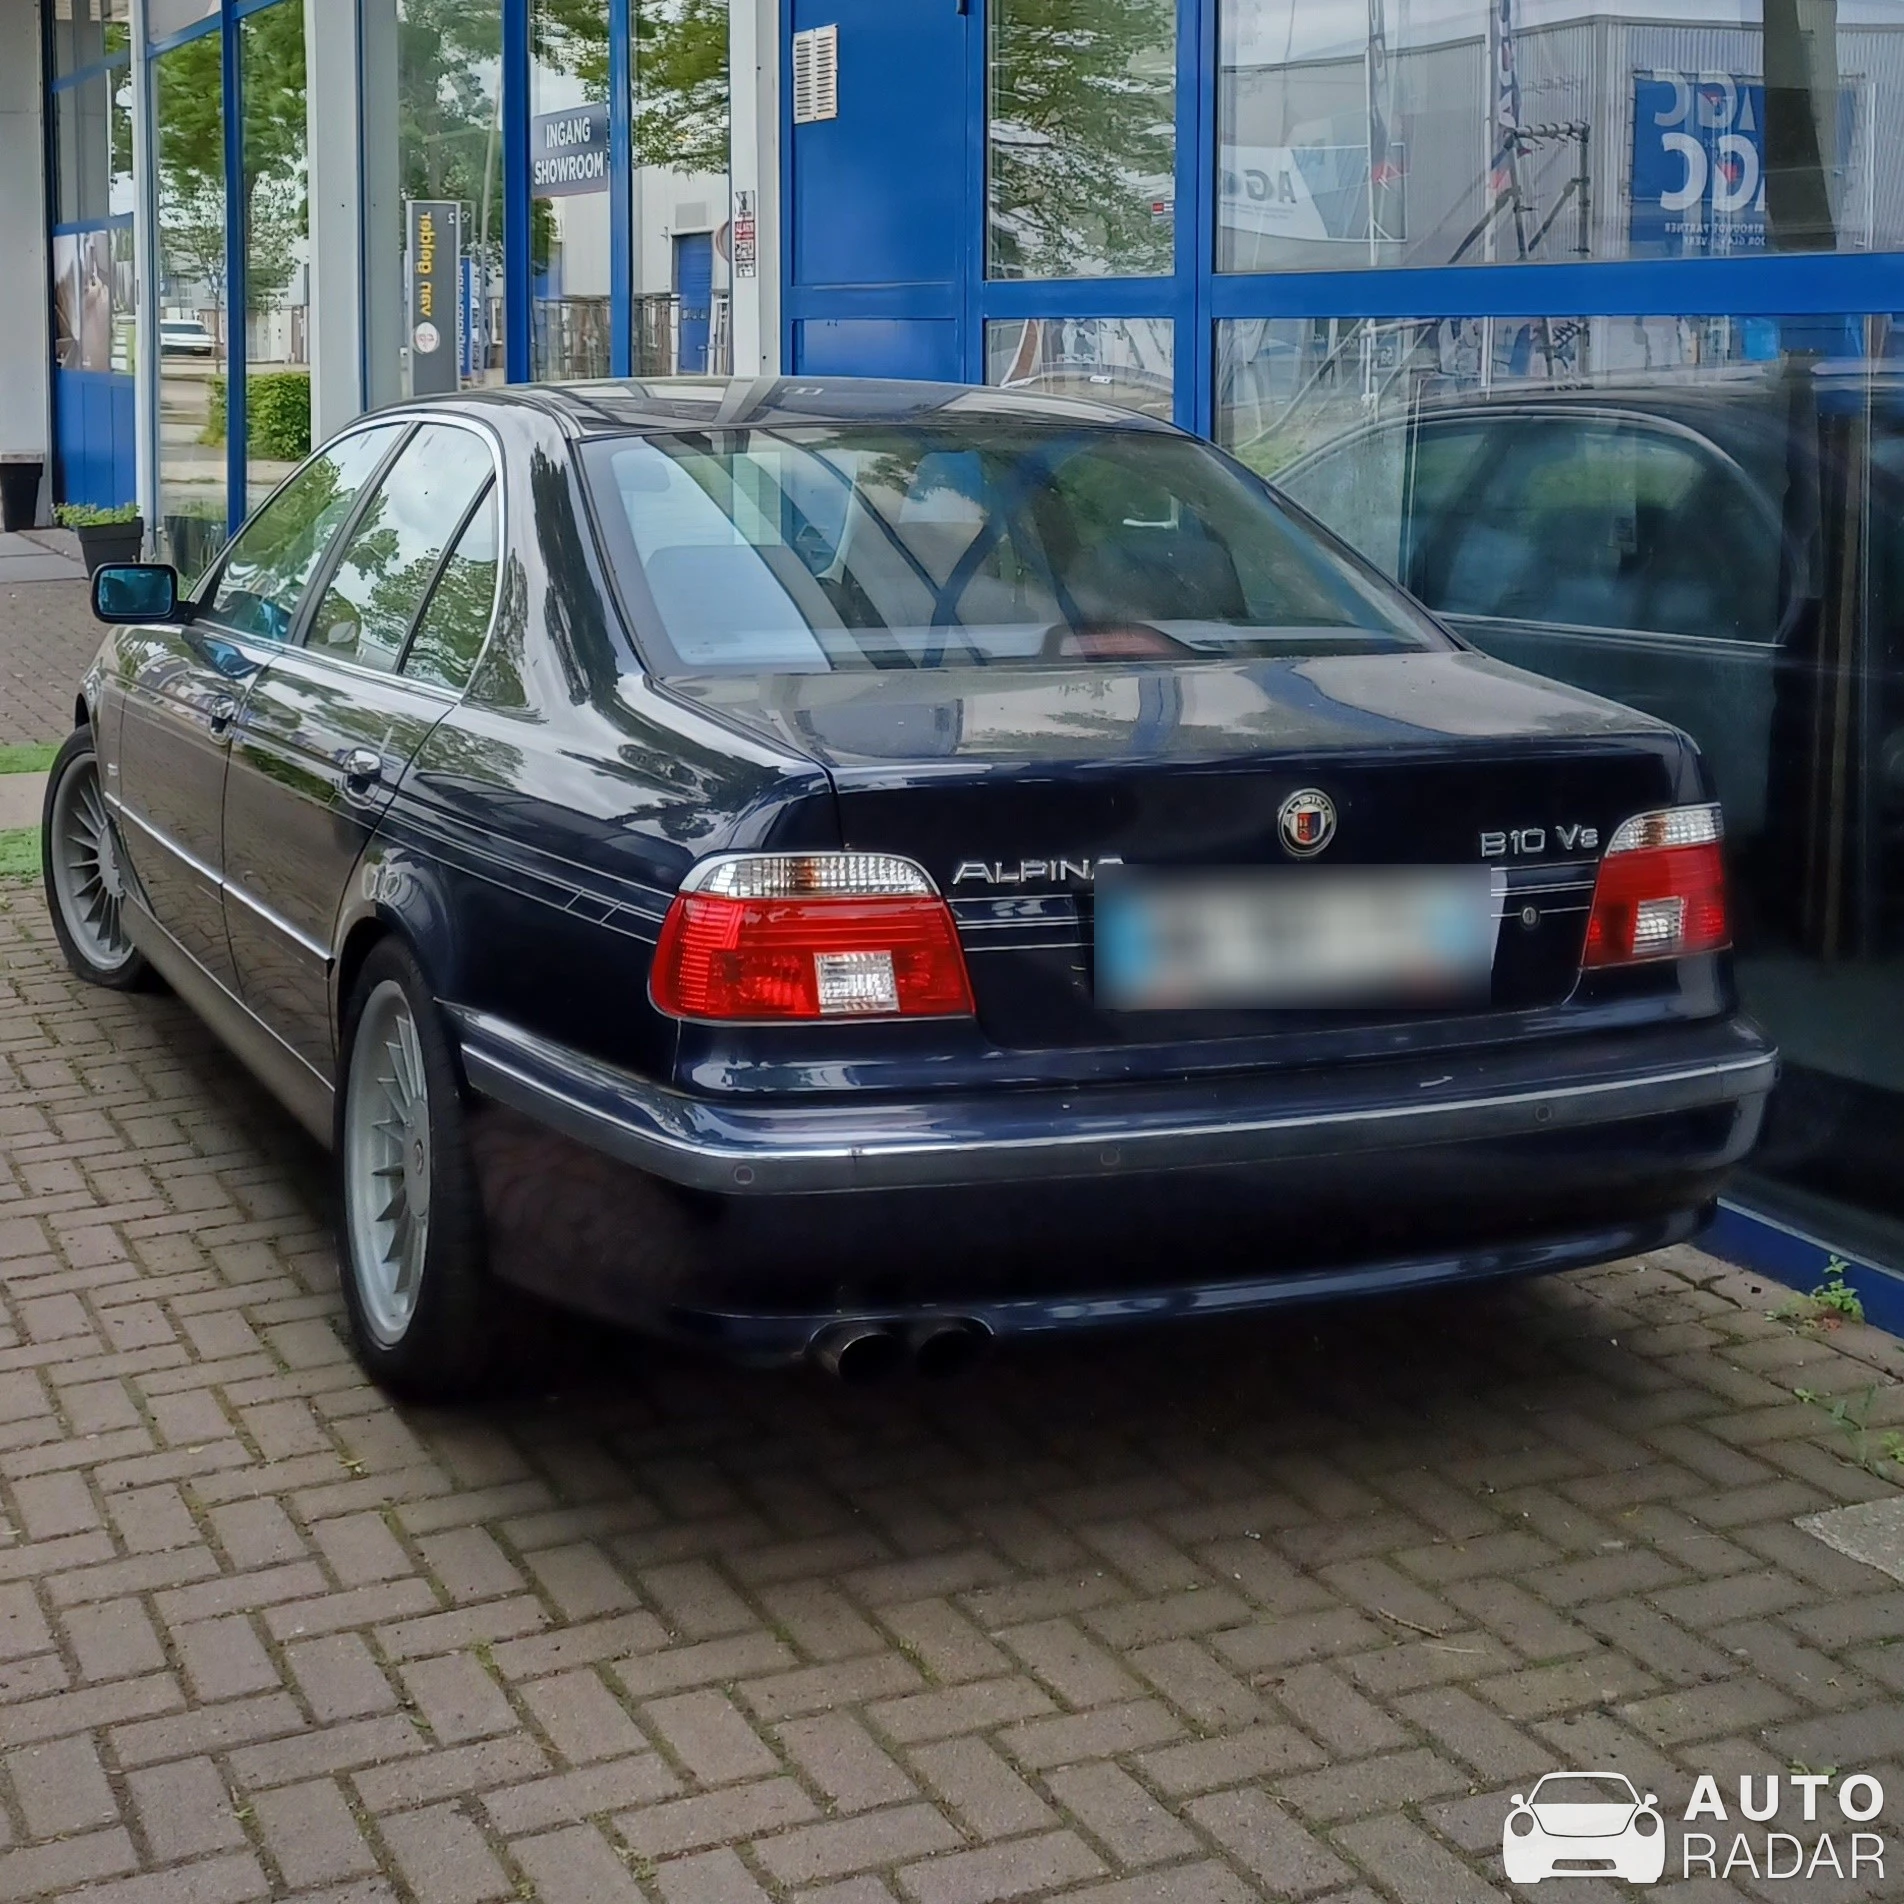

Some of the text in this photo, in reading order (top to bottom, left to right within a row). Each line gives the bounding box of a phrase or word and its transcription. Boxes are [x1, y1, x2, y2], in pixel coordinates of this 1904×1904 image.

[546, 117, 591, 149] INGANG
[534, 151, 604, 185] SHOWROOM
[1480, 823, 1598, 858] B10 V8
[952, 857, 1124, 885] ALPIN
